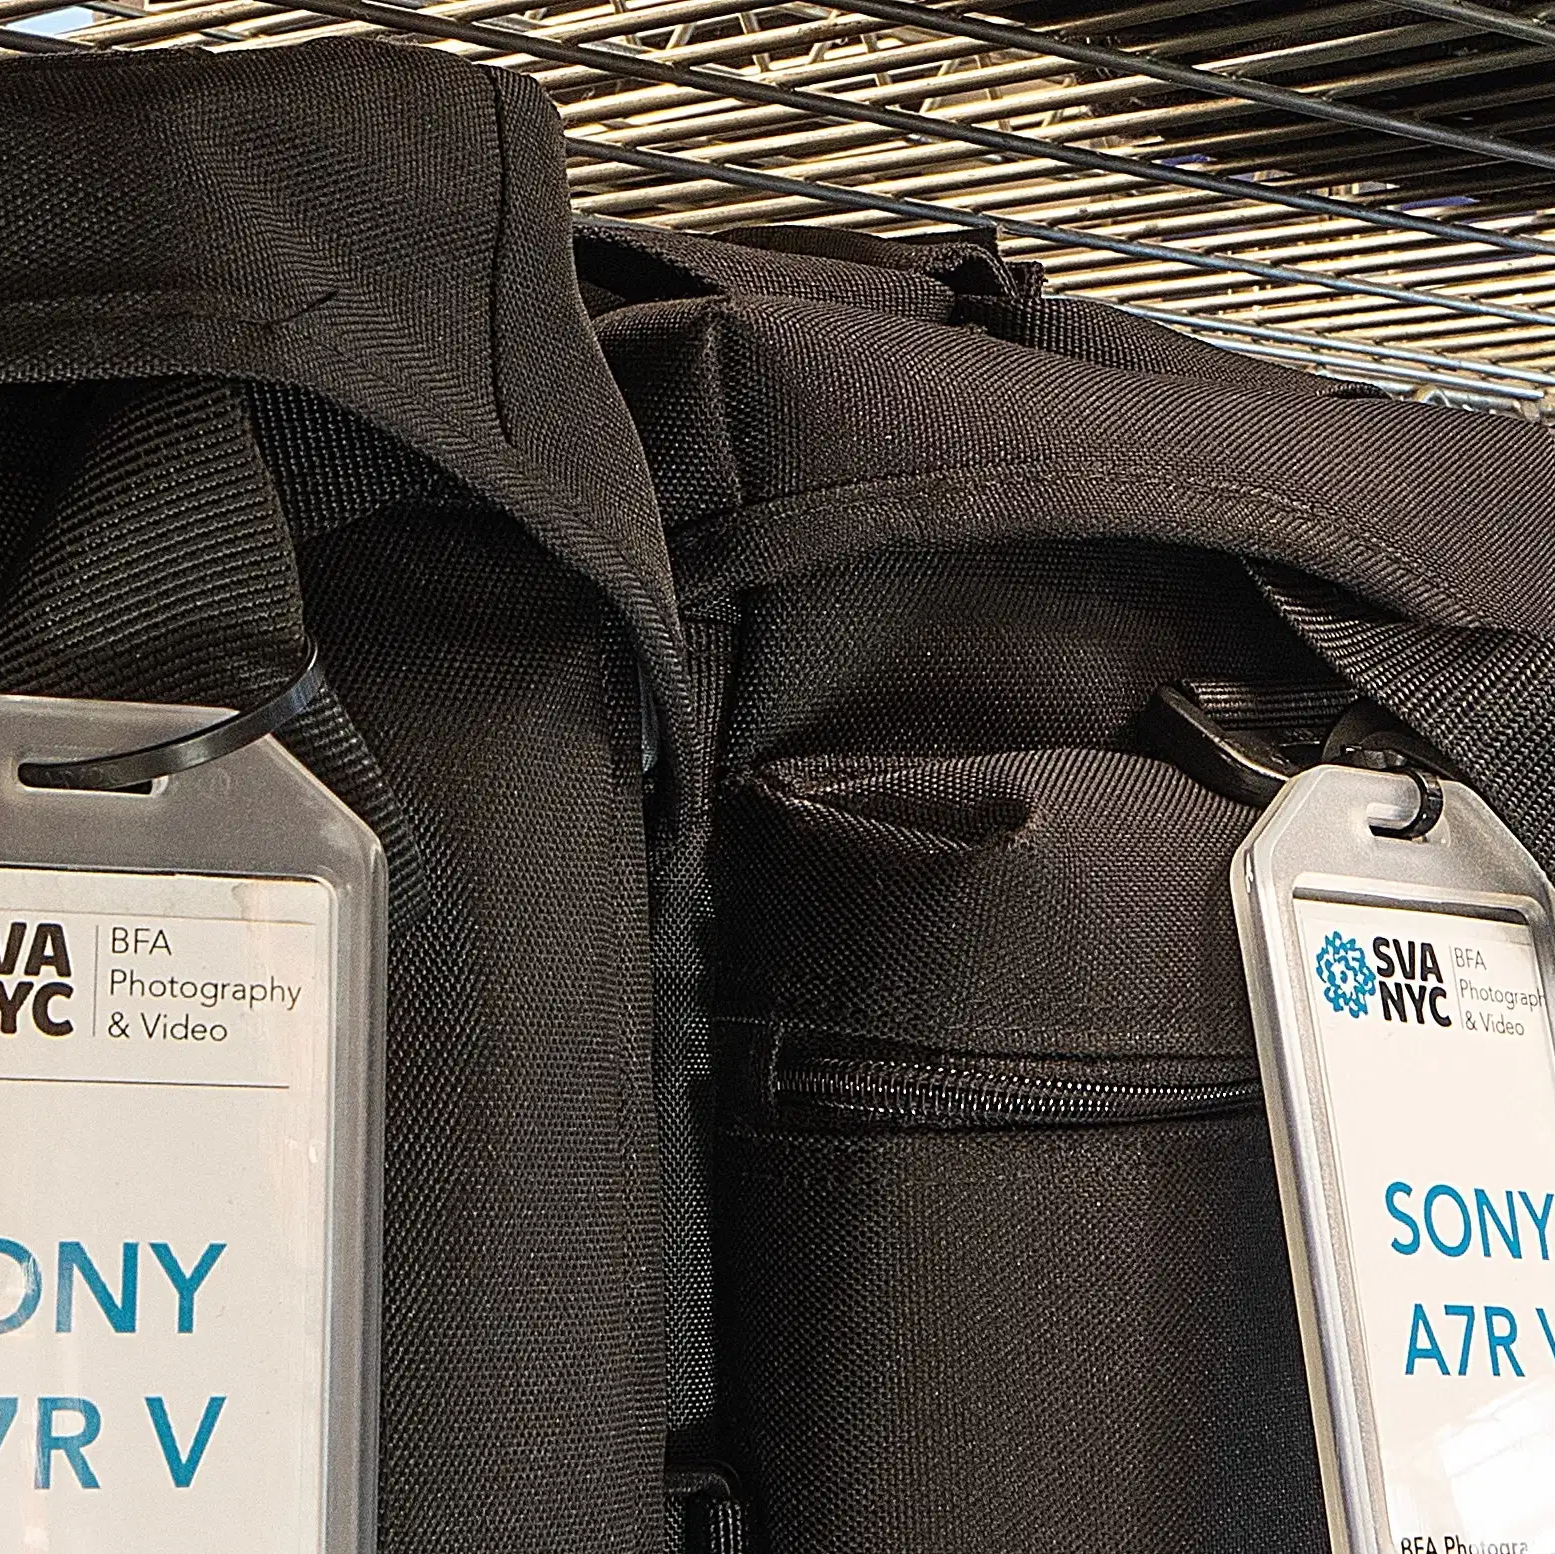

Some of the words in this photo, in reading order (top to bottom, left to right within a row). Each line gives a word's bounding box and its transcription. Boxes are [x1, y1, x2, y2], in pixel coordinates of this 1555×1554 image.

[110, 928, 173, 956] BFA
[1372, 936, 1444, 984] SVA
[1454, 947, 1488, 971] BFA
[110, 969, 302, 1011] Photography
[1378, 980, 1453, 1028] NYC
[1459, 978, 1547, 1010] Photograph
[107, 1012, 130, 1039] &
[143, 1013, 229, 1043] Video
[1465, 1011, 1479, 1032] &
[1482, 1013, 1525, 1036] Video
[1384, 1181, 1555, 1260] SONY
[1404, 1303, 1526, 1378] A7R
[144, 1395, 228, 1489] V
